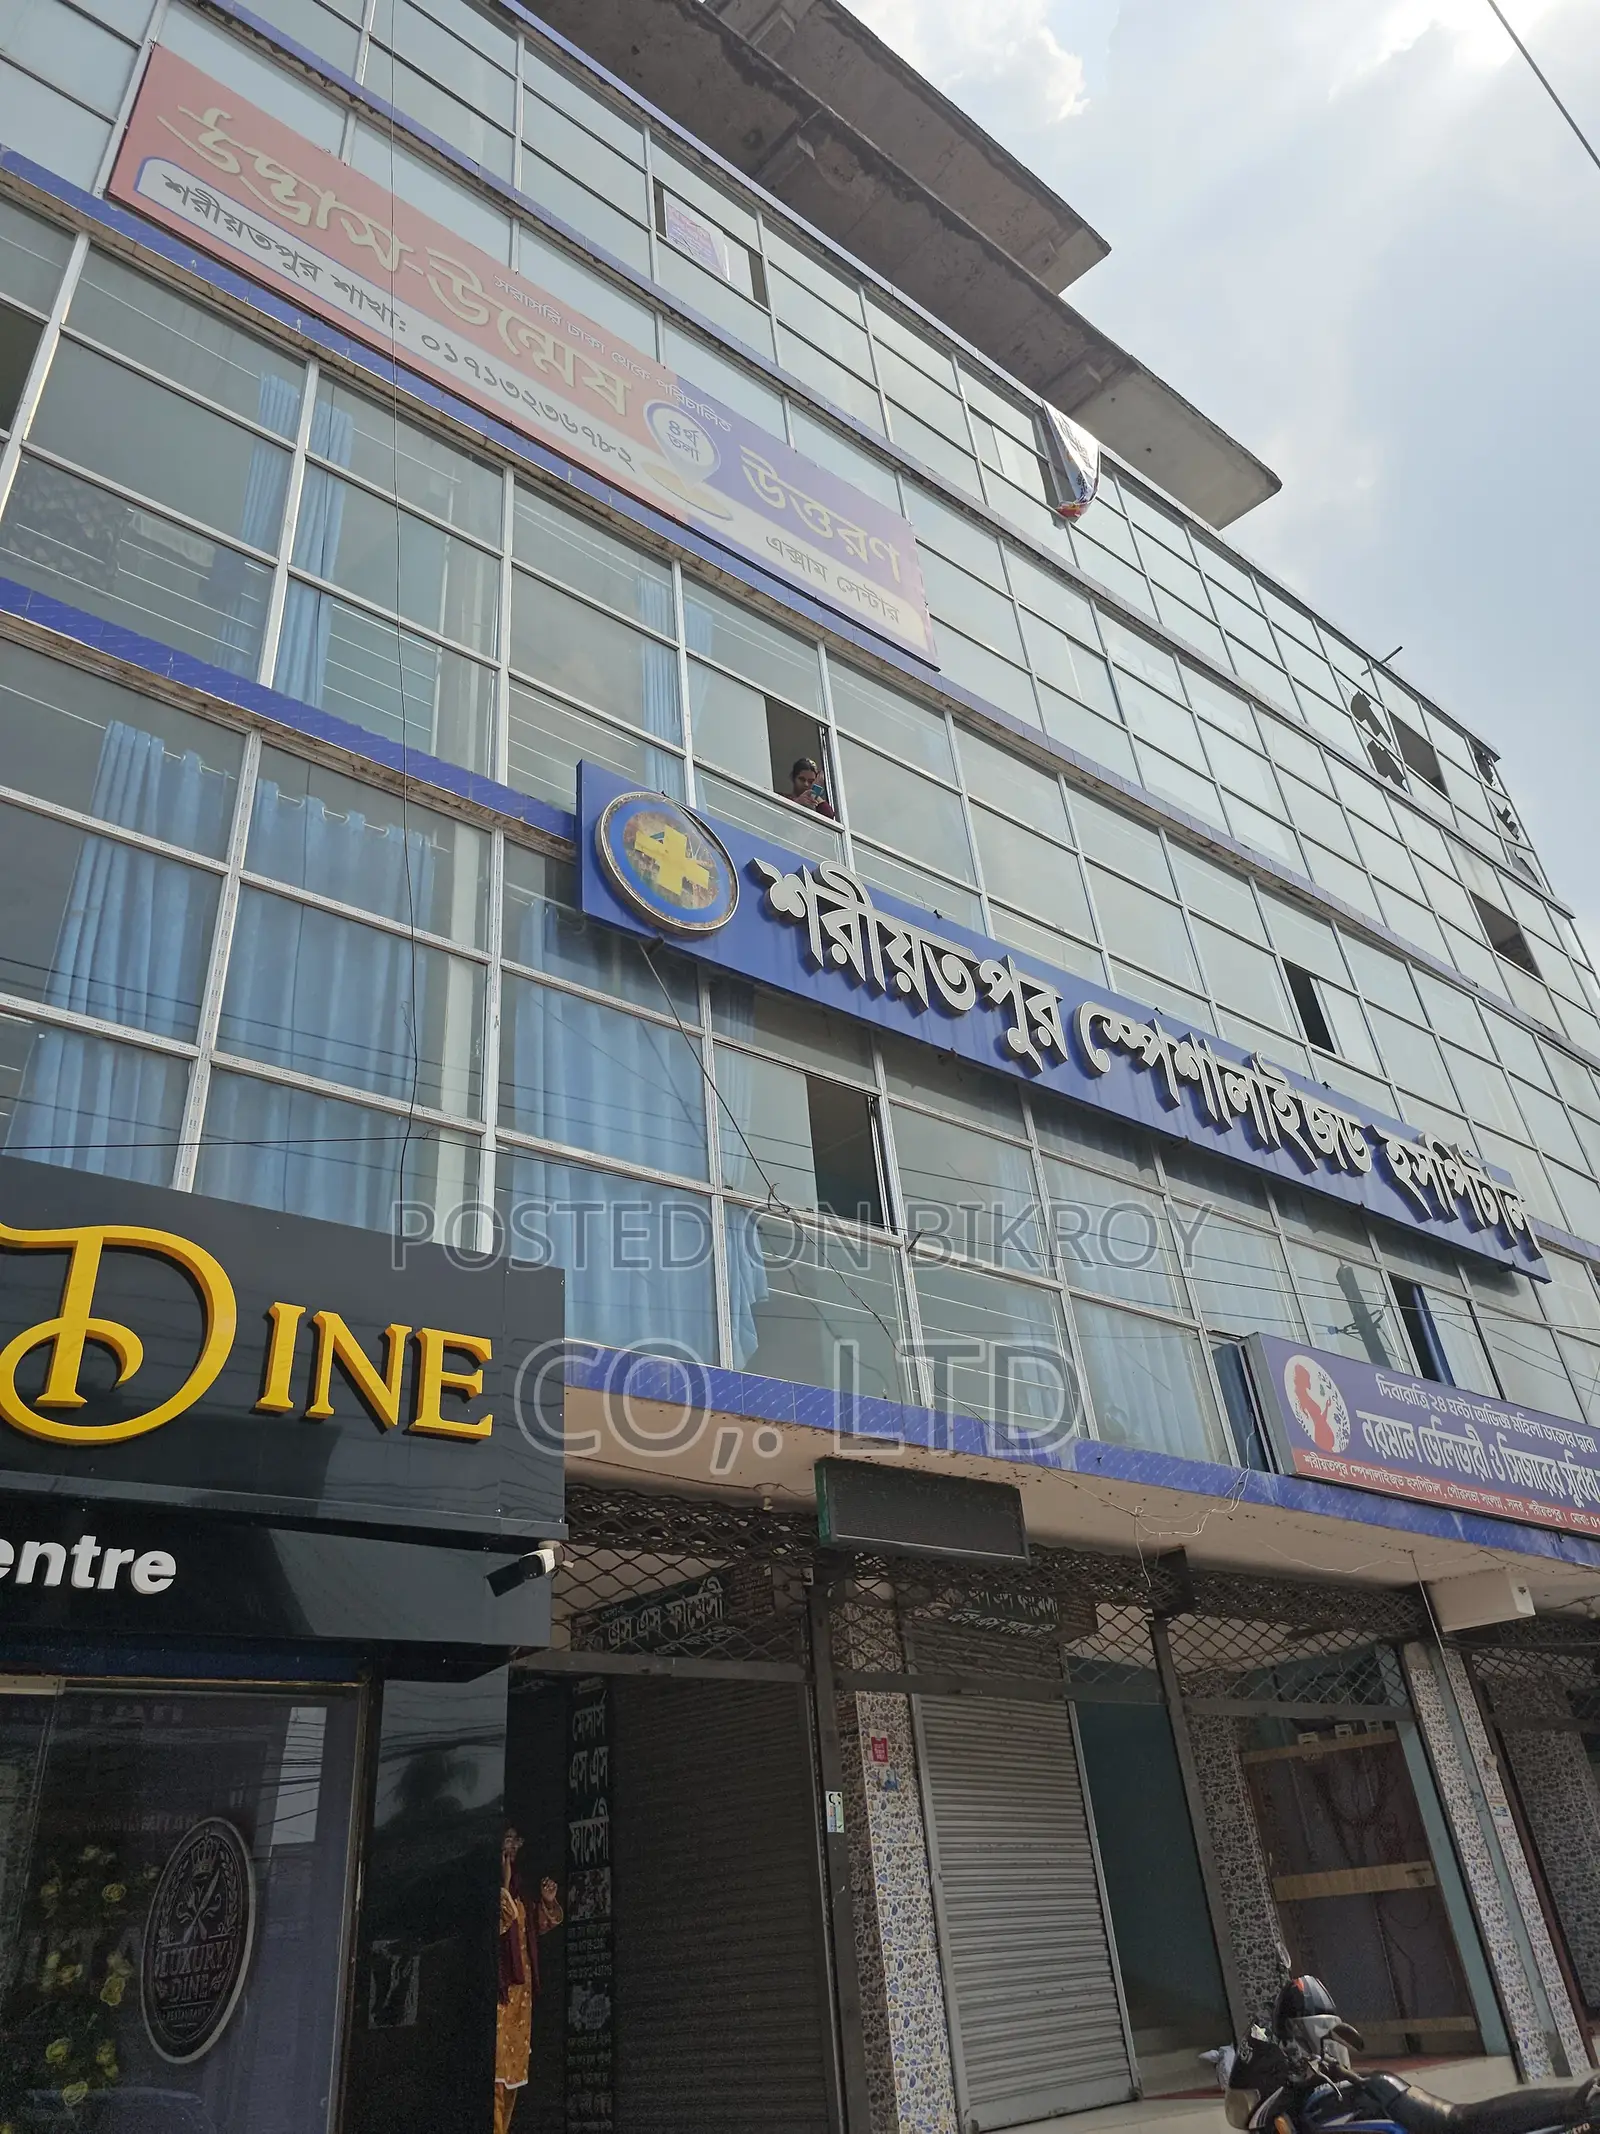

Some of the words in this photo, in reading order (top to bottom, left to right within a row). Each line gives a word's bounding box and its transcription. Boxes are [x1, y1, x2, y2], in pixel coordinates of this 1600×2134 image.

[161, 173, 323, 282] শরীয়তপুর
[421, 334, 636, 472] ০১৭১৩২৩৬৭৮২
[493, 275, 562, 327] সরাসরি
[566, 320, 605, 355] ঢাকা
[611, 351, 651, 381] থেকে
[656, 377, 732, 432] পরিচালিত
[740, 445, 901, 584] উত্তরণ
[765, 534, 829, 582] এক্সাম
[837, 574, 901, 625] সেন্টার
[752, 858, 1069, 1074] শরীয়তপুর
[1074, 1000, 1373, 1173] স্পেশালাইজড
[1366, 1124, 1543, 1260] হসপিটাল
[1356, 1410, 1423, 1463] নরমাল
[1418, 1415, 1493, 1482] ডেলিভারী
[1488, 1443, 1507, 1482] ও
[1430, 1393, 1447, 1413] ২৪
[158, 1940, 229, 1979] LUXURY
[167, 1974, 209, 2003] DINE
